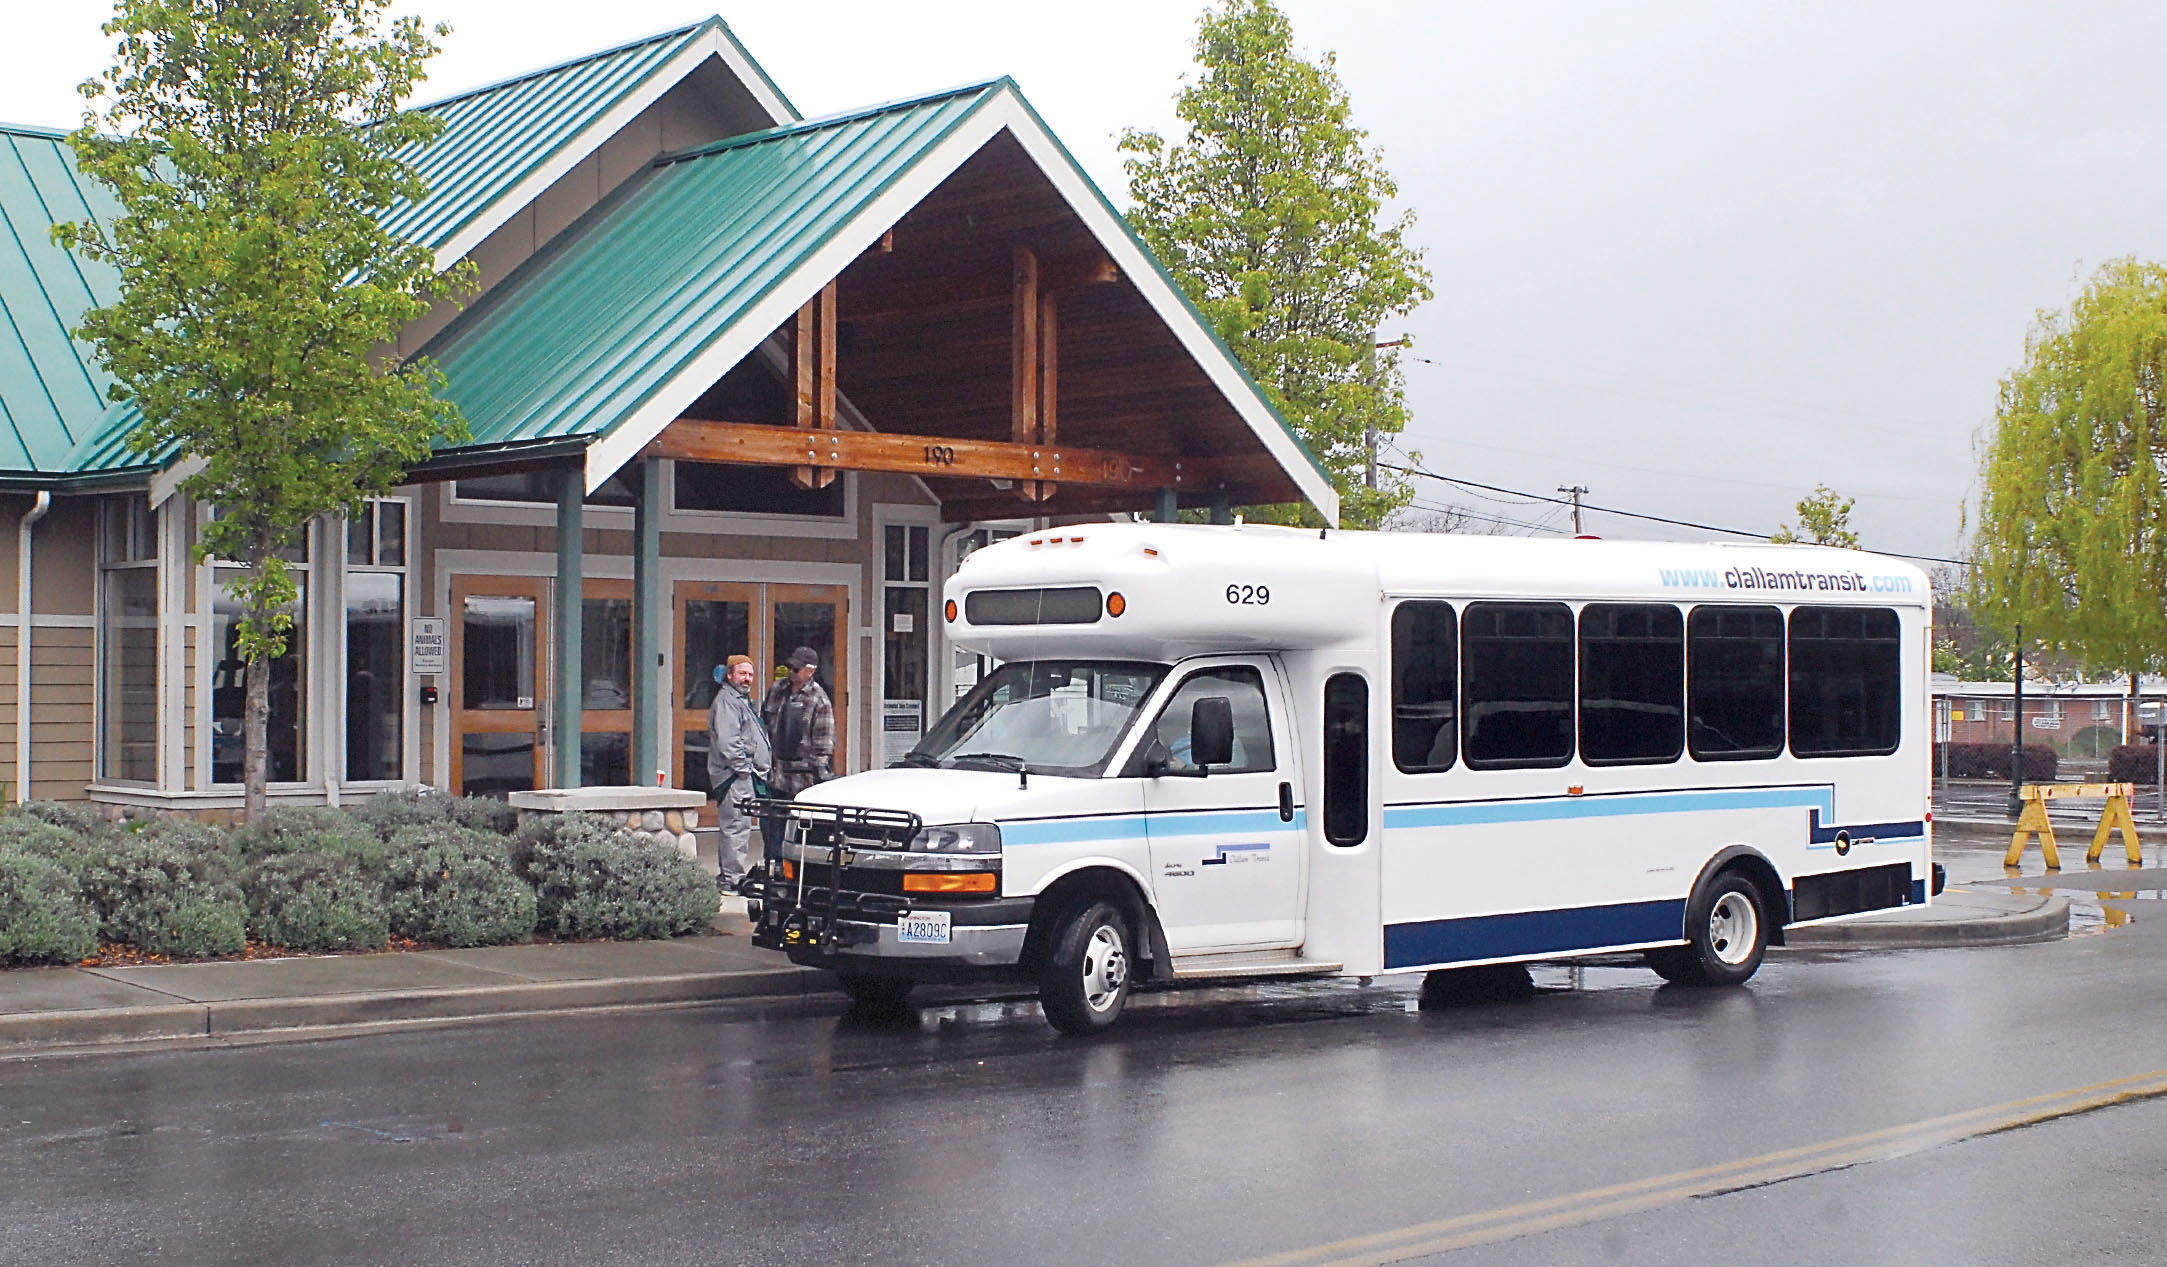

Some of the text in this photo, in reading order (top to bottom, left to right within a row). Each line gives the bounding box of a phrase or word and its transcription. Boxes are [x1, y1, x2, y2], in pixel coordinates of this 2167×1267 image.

[924, 446, 954, 465] 190
[1659, 566, 1913, 593] www.clallamtransit.com
[1226, 584, 1270, 605] 629
[424, 624, 433, 633] NO
[415, 635, 442, 645] ANIMALS
[415, 646, 442, 656] ALLOWED
